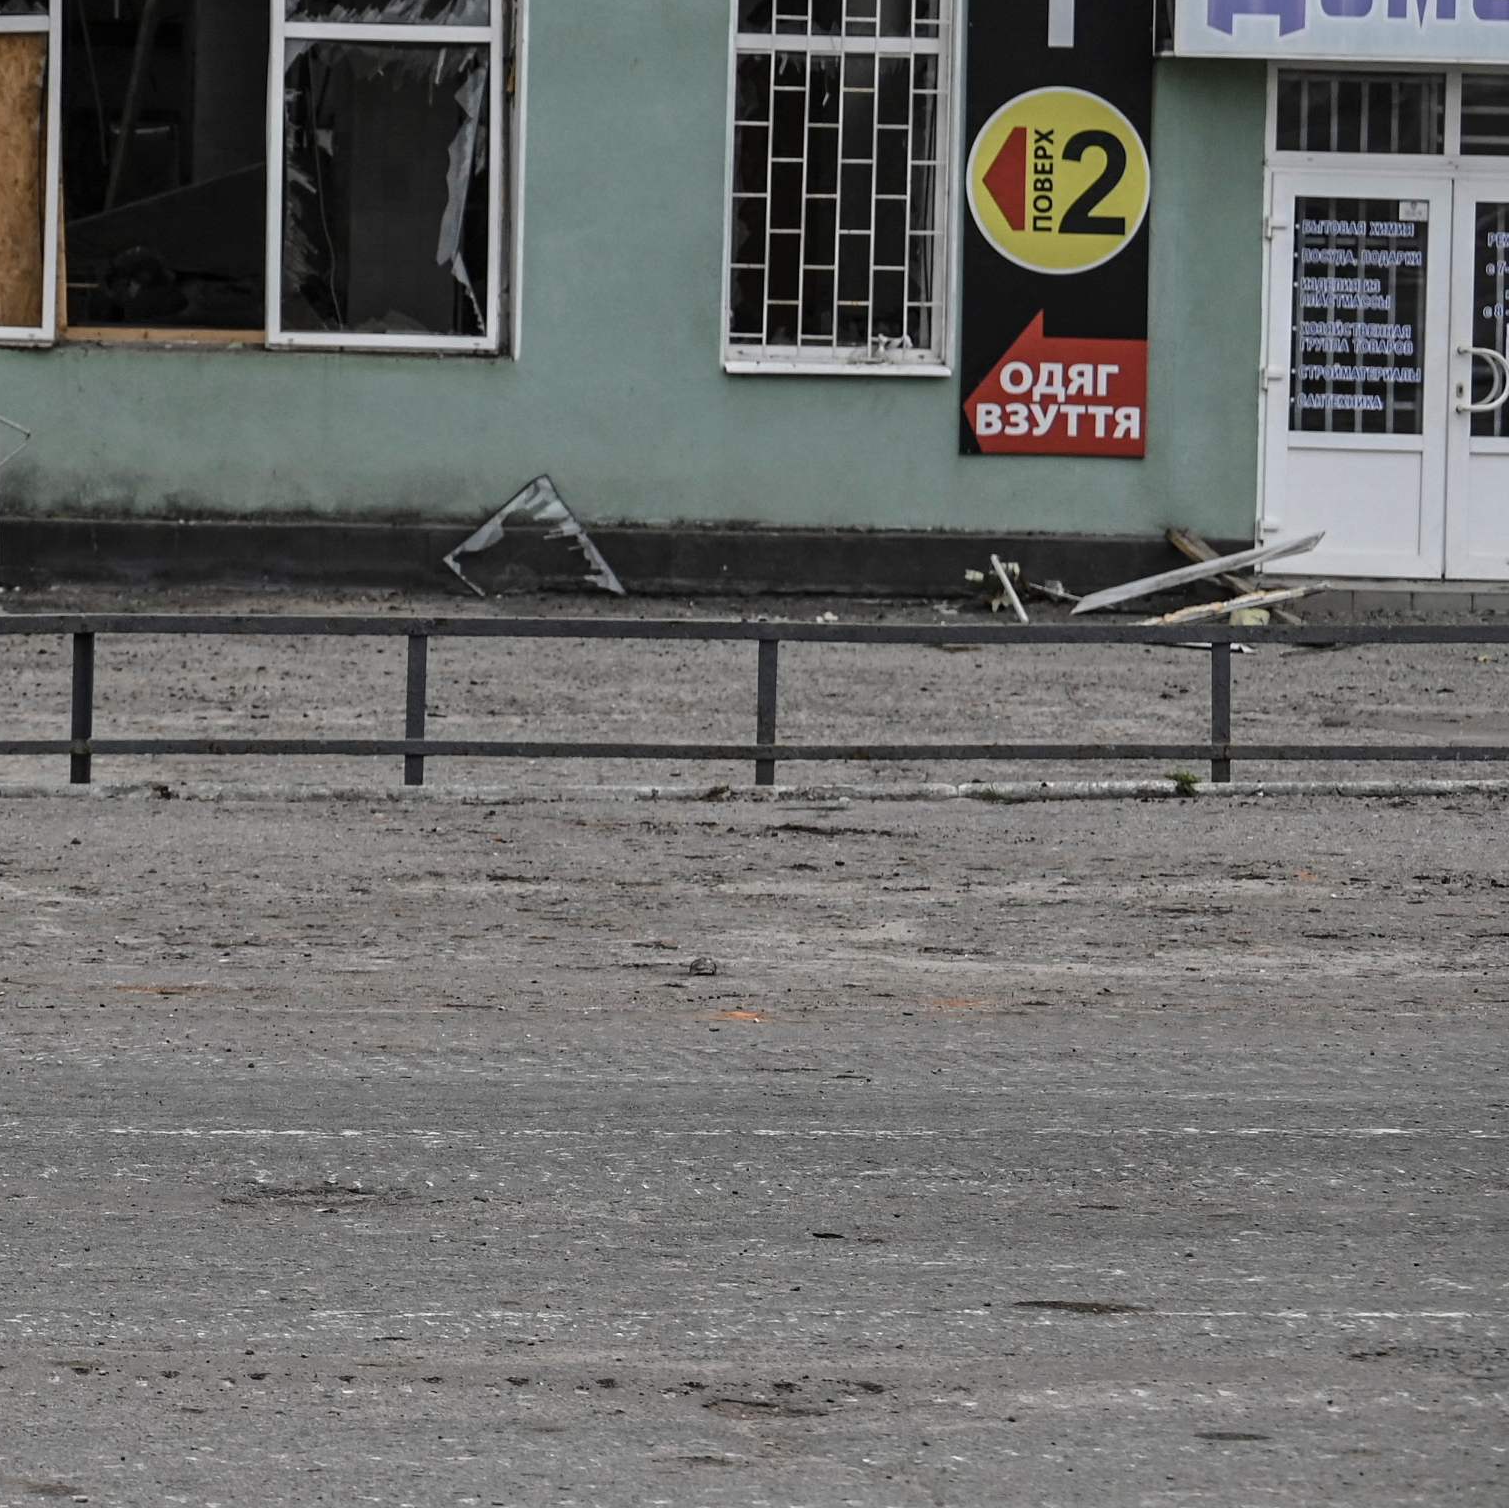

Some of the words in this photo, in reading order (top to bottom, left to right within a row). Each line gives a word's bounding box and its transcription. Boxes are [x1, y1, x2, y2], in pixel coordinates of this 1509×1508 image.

[1032, 127, 1054, 233] ПОВЕРХ
[1058, 129, 1127, 236] 2
[1302, 220, 1366, 236] БЫТОВАЯ
[1369, 222, 1414, 237] ХИМИЯ
[1302, 248, 1357, 266] ПОСУДА,
[1361, 249, 1422, 268] ПОДАРКИ
[1300, 293, 1391, 310] ПЛАСТМАССЫ
[1300, 337, 1349, 353] ГРУППА
[1352, 339, 1413, 356] ТОВАРОВ
[999, 362, 1119, 400] ОДЯГ
[1298, 363, 1422, 383] СТРОЙМАТЕРИАЛЫ
[1297, 393, 1383, 410] САНТЕХНИКА
[976, 401, 1141, 440] ВЗУТТЯ
